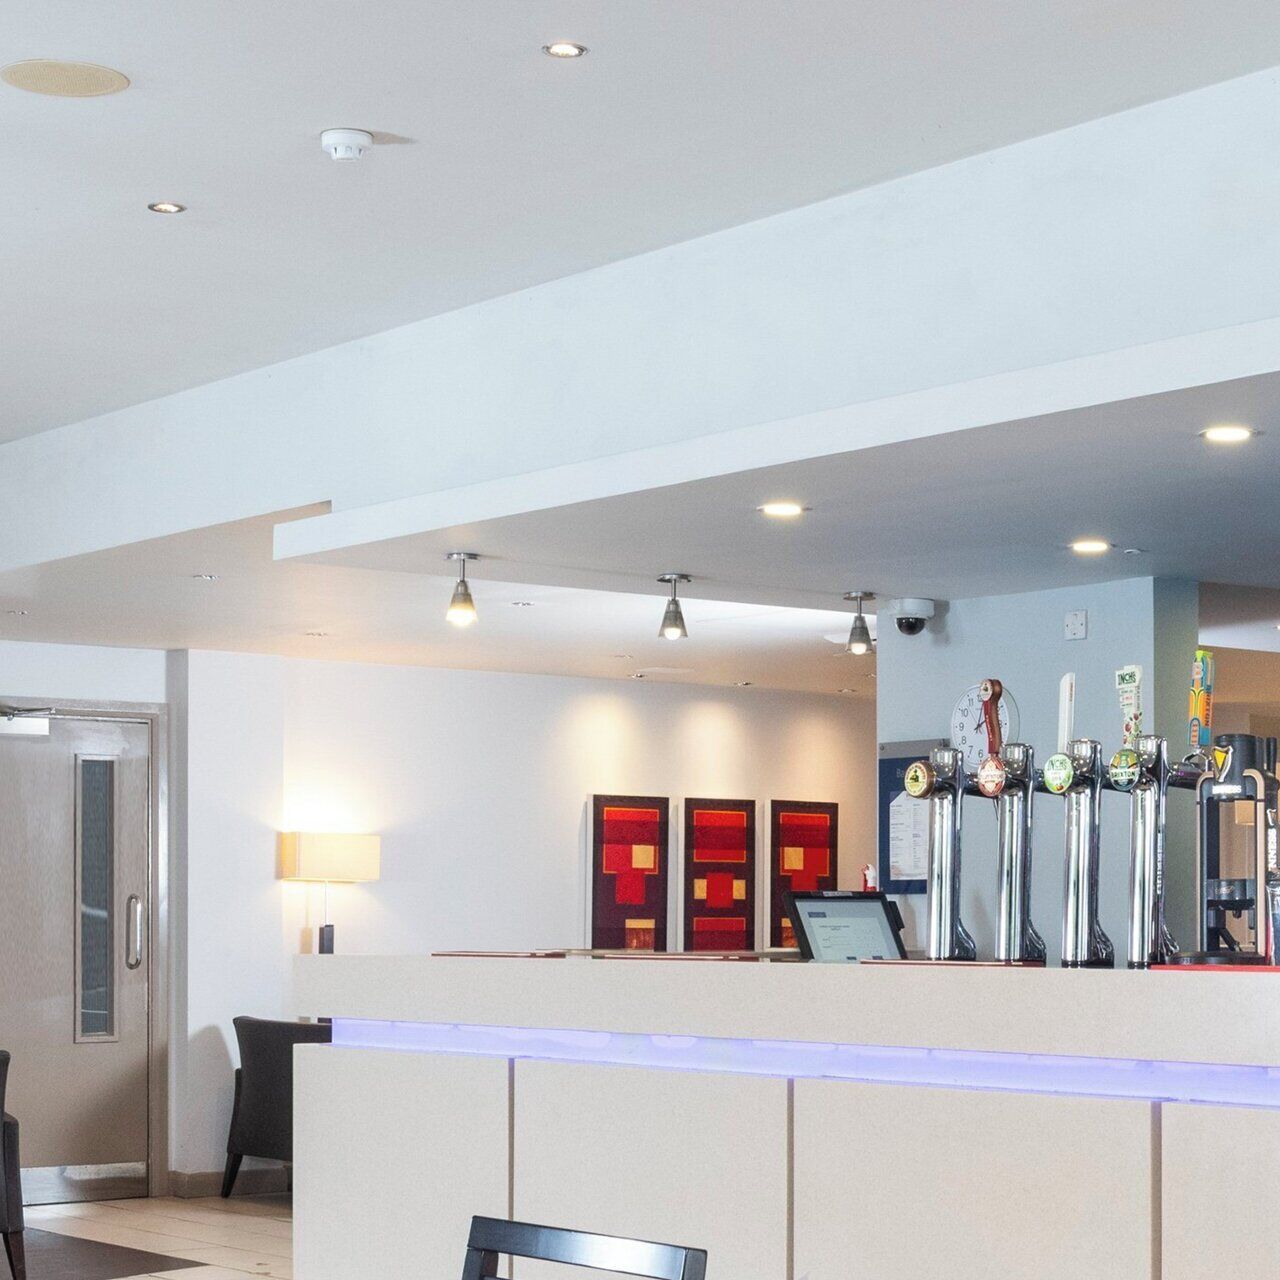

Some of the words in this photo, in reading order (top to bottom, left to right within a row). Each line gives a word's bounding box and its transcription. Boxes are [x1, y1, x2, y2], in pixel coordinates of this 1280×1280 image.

[961, 708, 968, 717] 10
[959, 722, 964, 731] 9
[962, 736, 967, 745] 8
[968, 746, 974, 755] 7
[978, 749, 984, 758] 6
